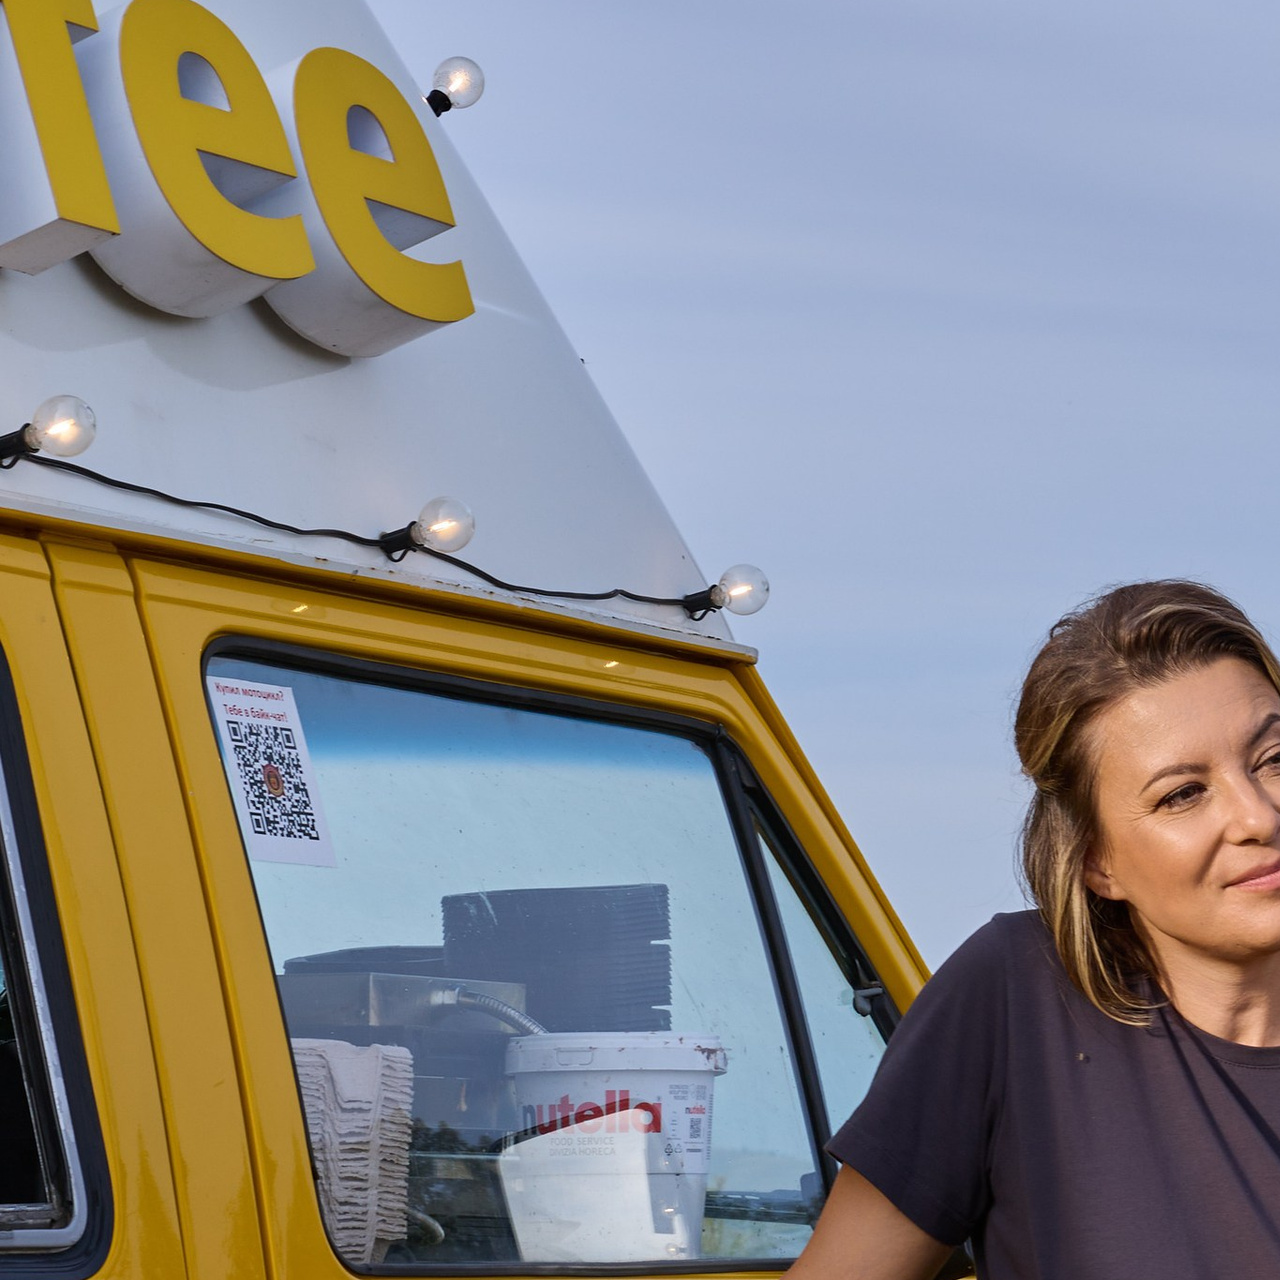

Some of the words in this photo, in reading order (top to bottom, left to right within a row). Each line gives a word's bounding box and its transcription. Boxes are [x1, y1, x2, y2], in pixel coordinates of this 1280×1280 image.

[215, 682, 240, 695] Купил
[241, 688, 283, 701] мотоцикл?
[223, 703, 244, 717] Тебе
[244, 708, 250, 718] в
[250, 706, 288, 722] байк-чат!
[522, 1090, 661, 1134] nutella
[550, 1137, 573, 1146] FOOD
[576, 1136, 615, 1146] SERVICE
[578, 1146, 616, 1156] HORECA
